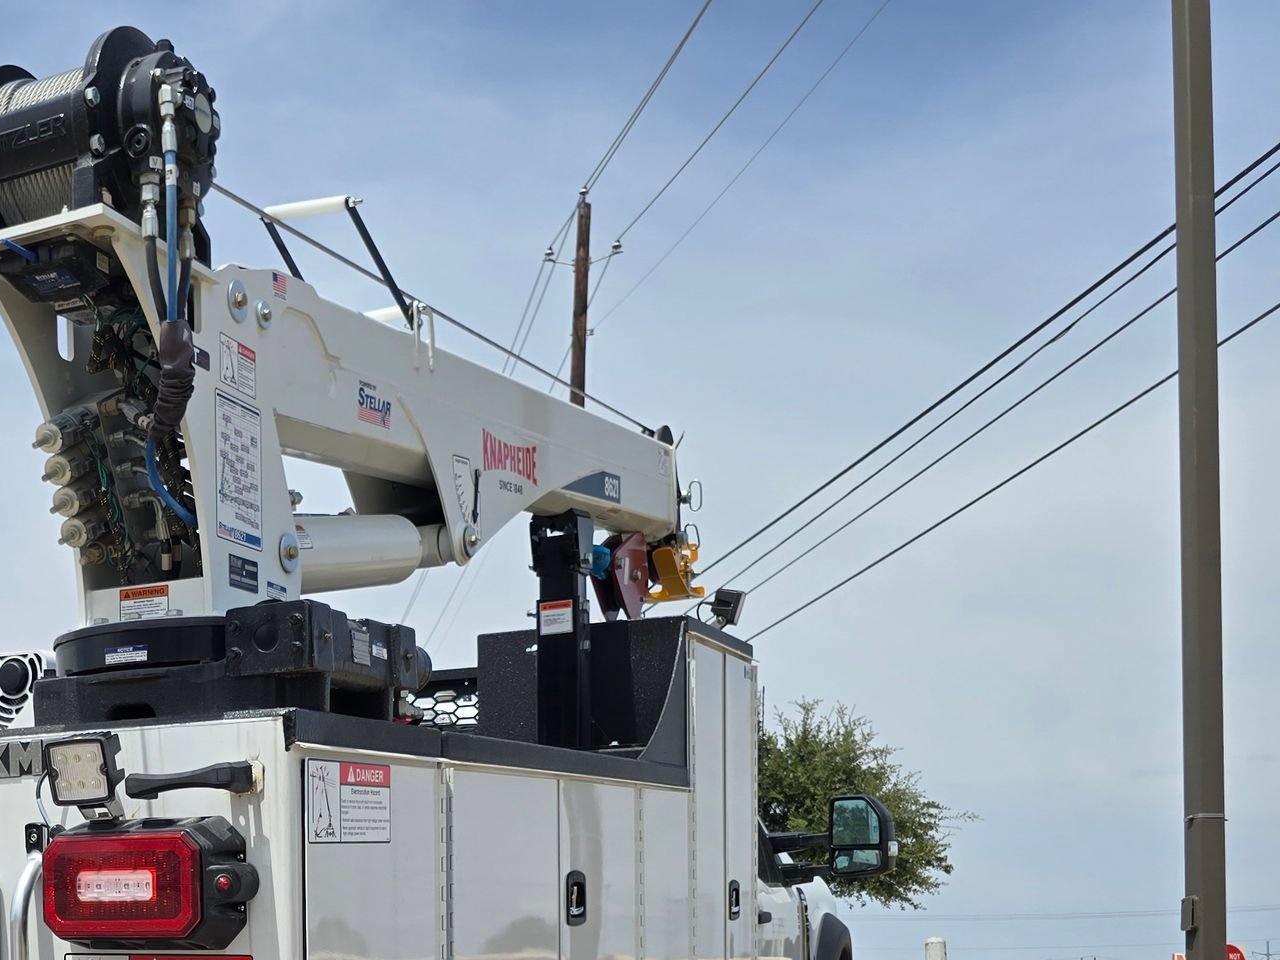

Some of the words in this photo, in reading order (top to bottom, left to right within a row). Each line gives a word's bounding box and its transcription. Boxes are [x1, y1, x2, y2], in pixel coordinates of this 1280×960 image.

[358, 387, 392, 416] STELLAR
[482, 428, 538, 486] KNAPHEIDE
[499, 480, 512, 493] SINCE
[604, 476, 619, 500] 8621
[131, 588, 164, 597] WARNING
[356, 769, 384, 783] DANGER
